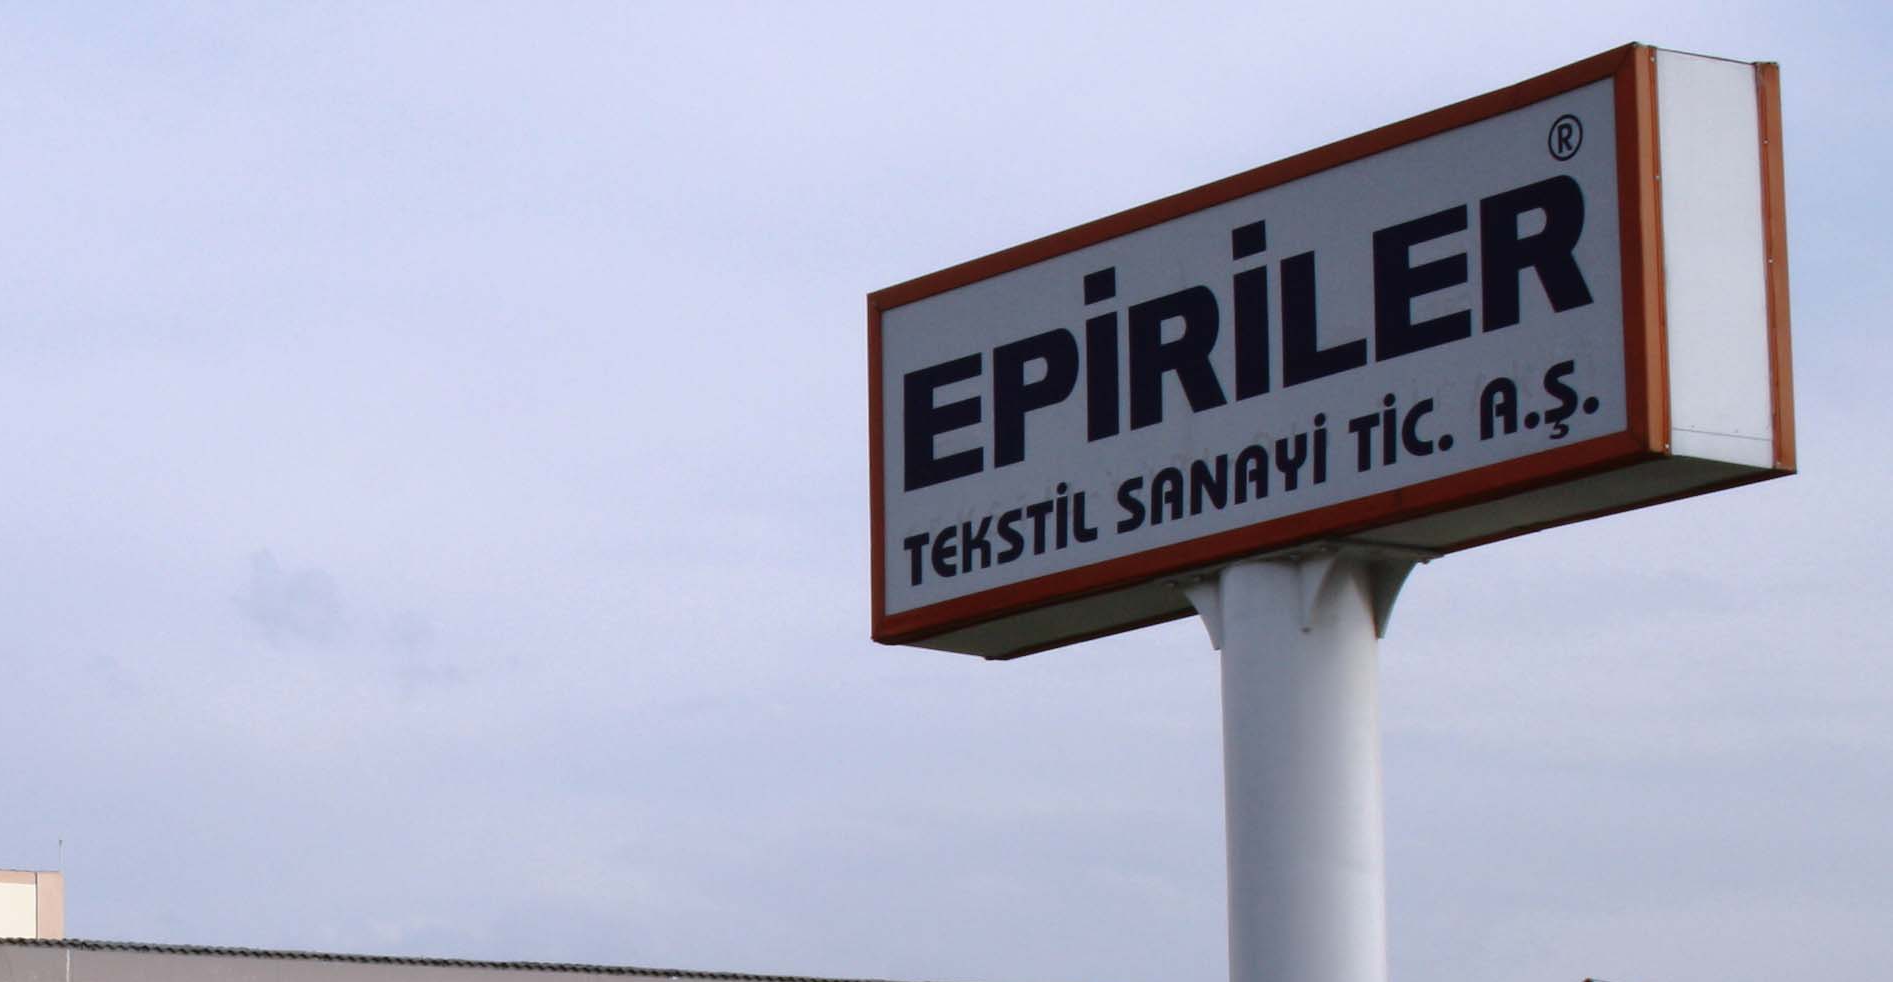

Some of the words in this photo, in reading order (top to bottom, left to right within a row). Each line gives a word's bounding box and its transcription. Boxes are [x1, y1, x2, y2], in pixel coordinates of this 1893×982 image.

[903, 174, 1595, 493] EPİRİLER
[903, 481, 1099, 588] TEKSTİL
[1114, 412, 1328, 536] SANAYİ
[1347, 392, 1455, 474] TİC.
[1478, 358, 1601, 443] A.Ş.
